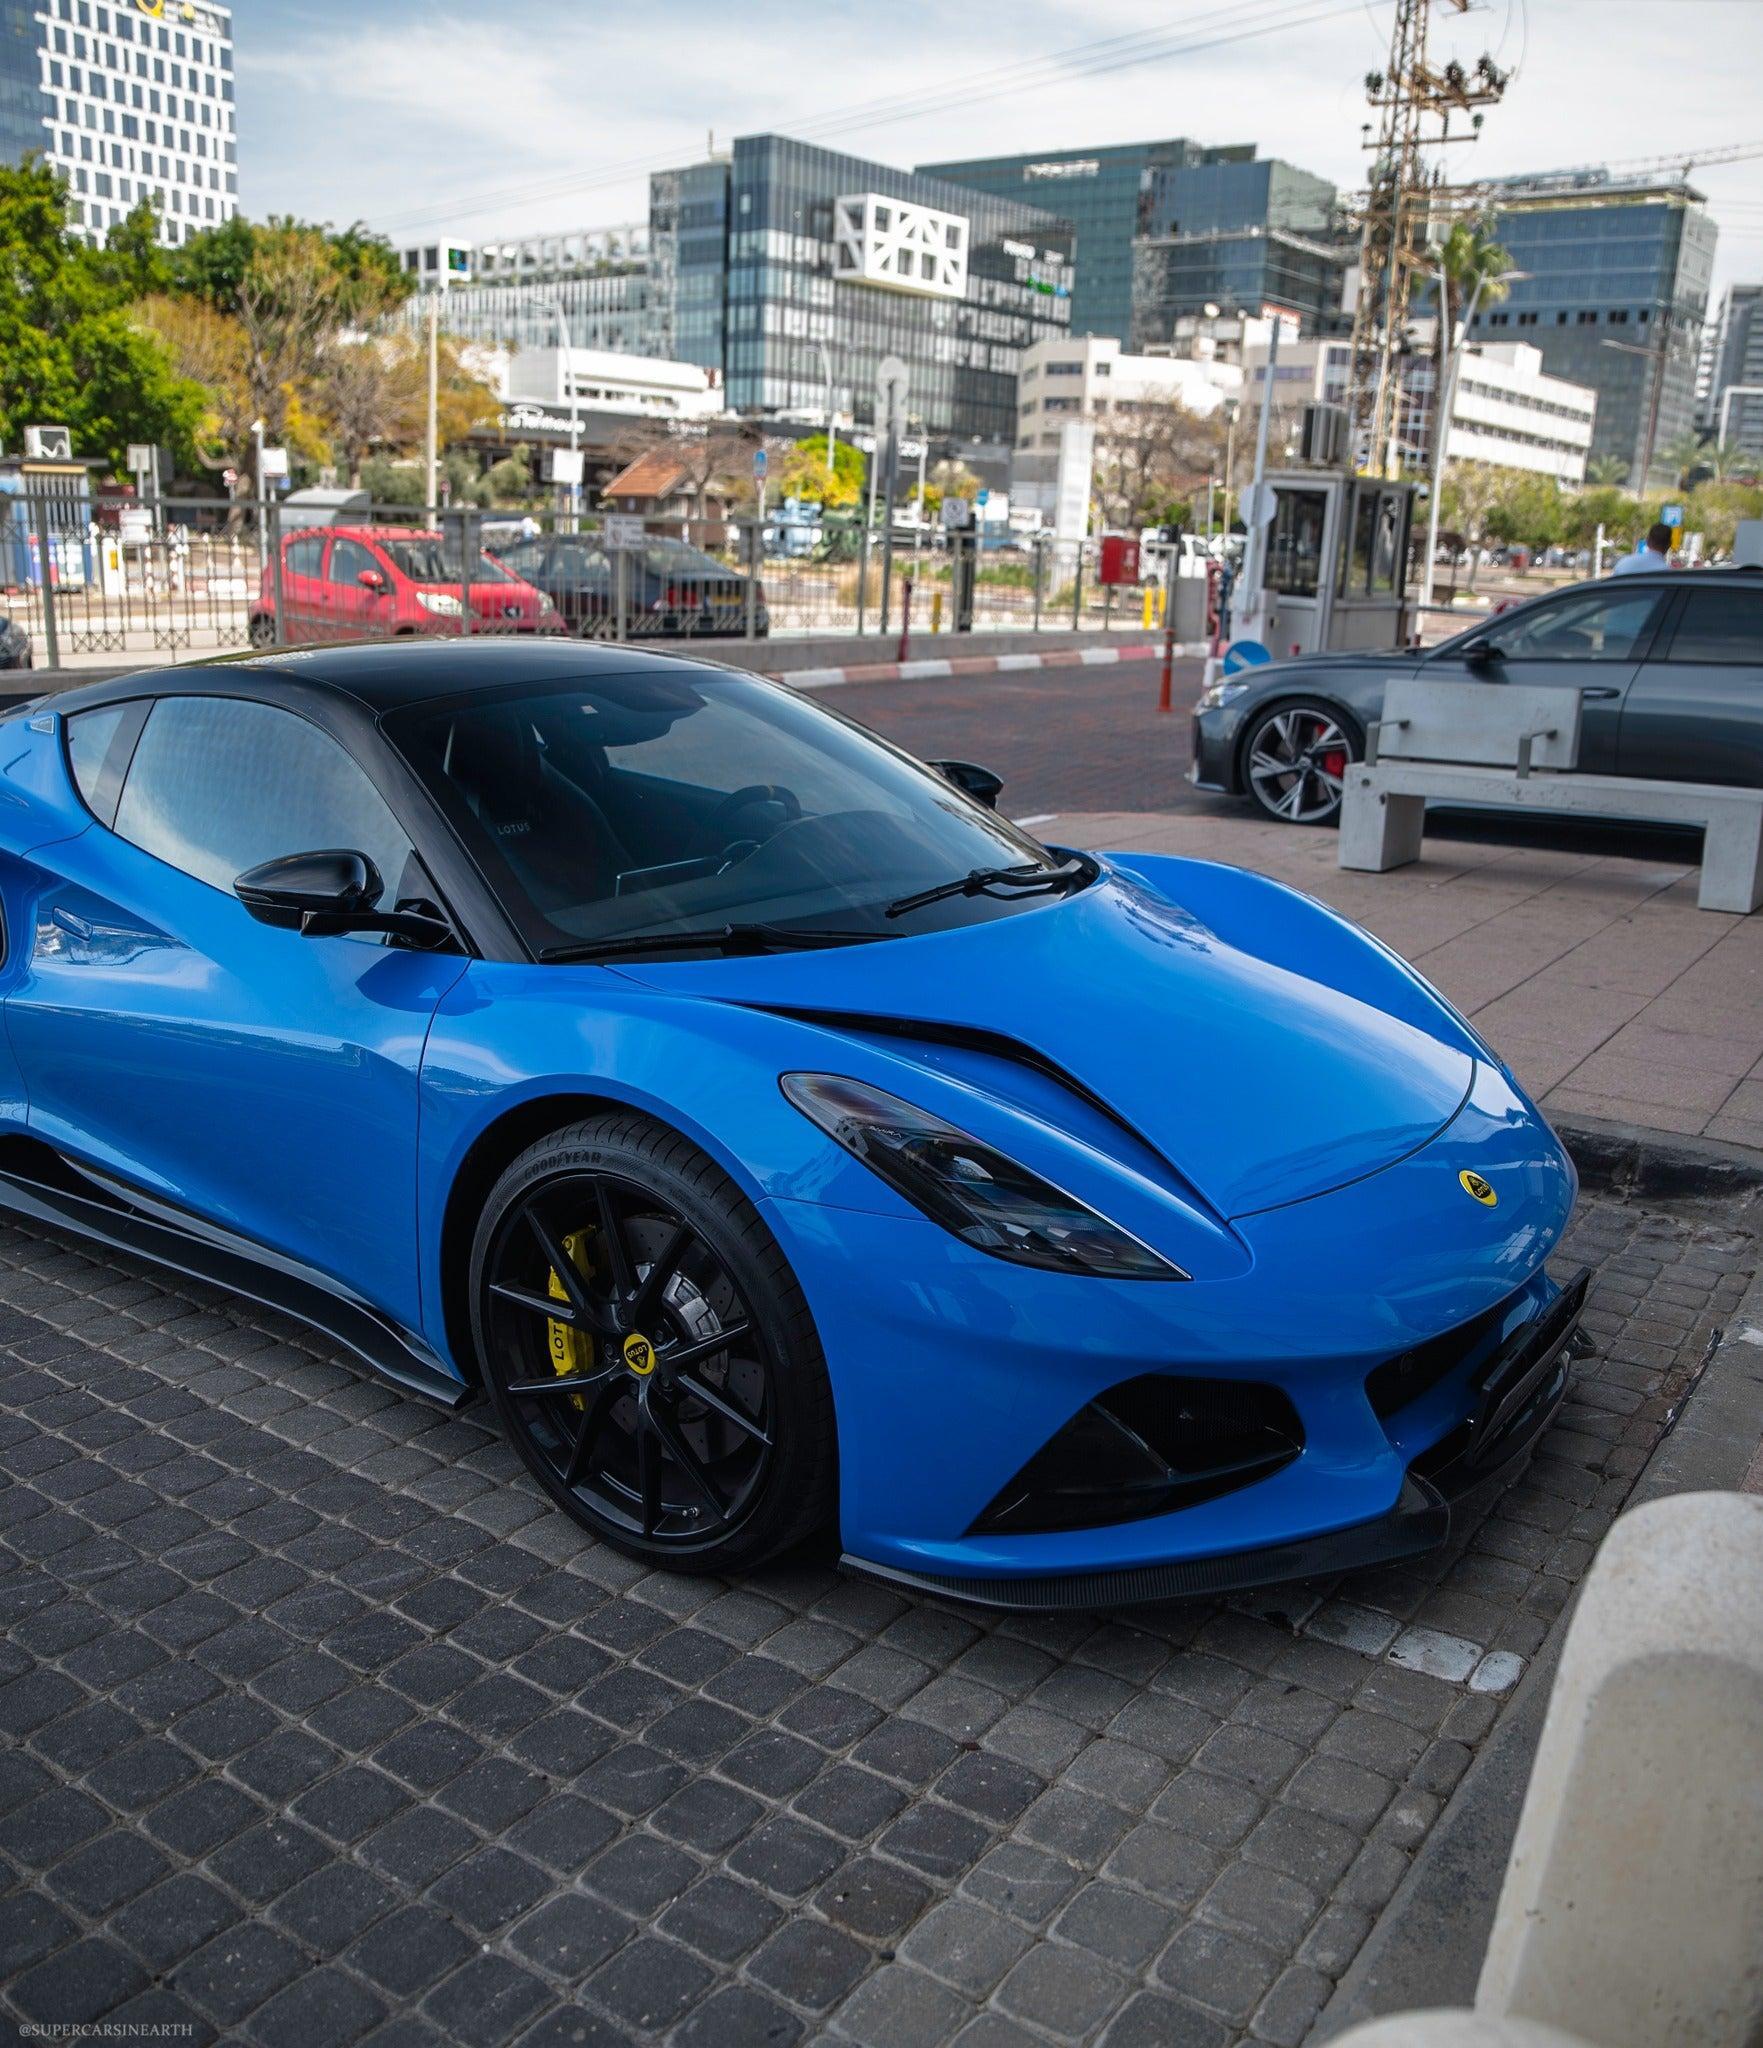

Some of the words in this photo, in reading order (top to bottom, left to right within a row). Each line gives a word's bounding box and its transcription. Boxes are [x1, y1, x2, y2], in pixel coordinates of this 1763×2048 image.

[498, 822, 531, 835] LOTUS
[524, 1151, 602, 1180] GOODYEAR
[552, 1324, 565, 1361] LOT
[627, 1344, 648, 1359] LOTUS
